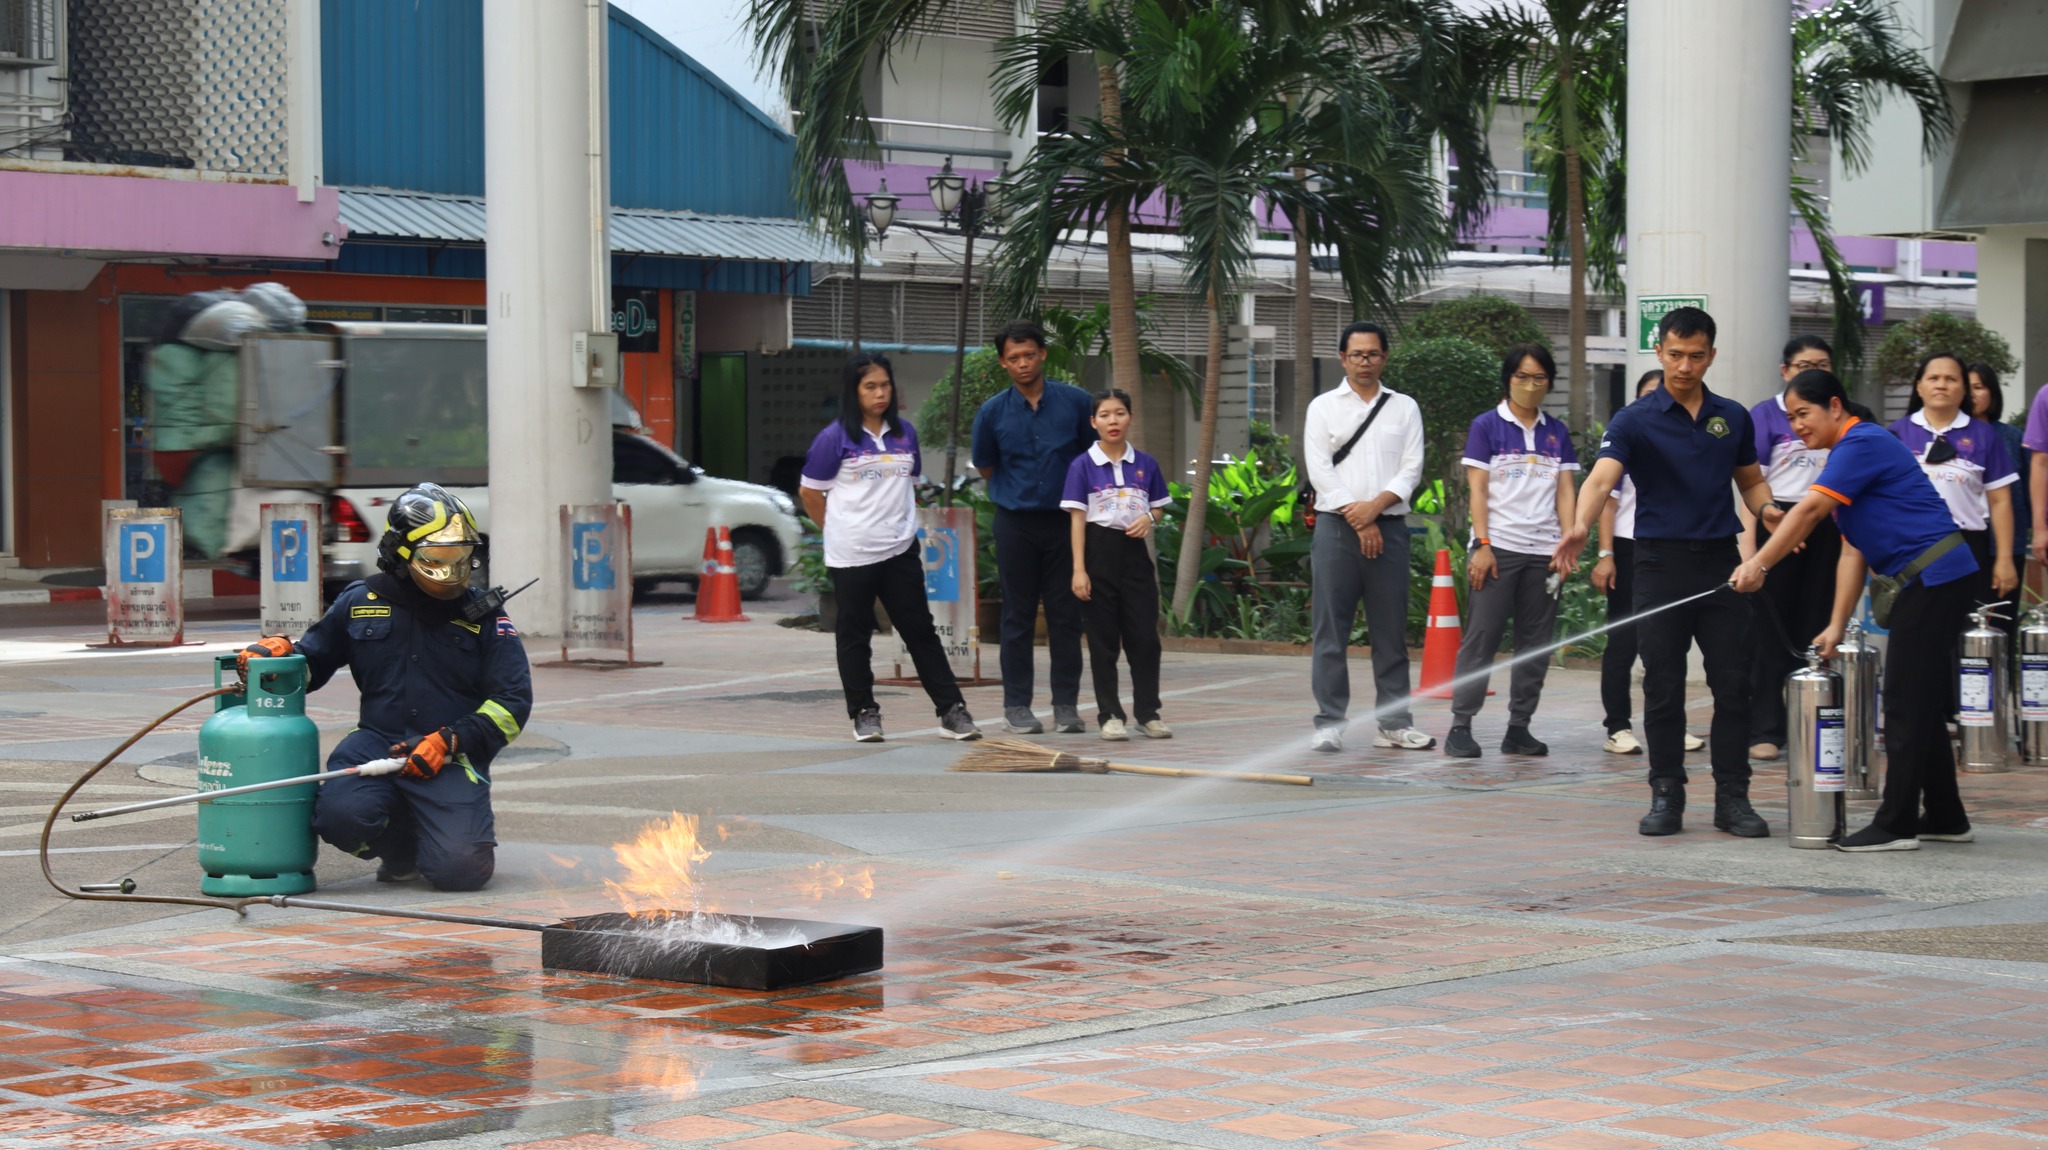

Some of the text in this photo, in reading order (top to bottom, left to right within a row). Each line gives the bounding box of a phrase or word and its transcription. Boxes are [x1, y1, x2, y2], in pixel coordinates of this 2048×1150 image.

[130, 531, 155, 576] P
[281, 527, 300, 575] P
[582, 530, 606, 582] P
[280, 602, 302, 612] นายก
[265, 617, 316, 629] สภามหาวิทยาลั
[255, 697, 285, 708] 16.2
